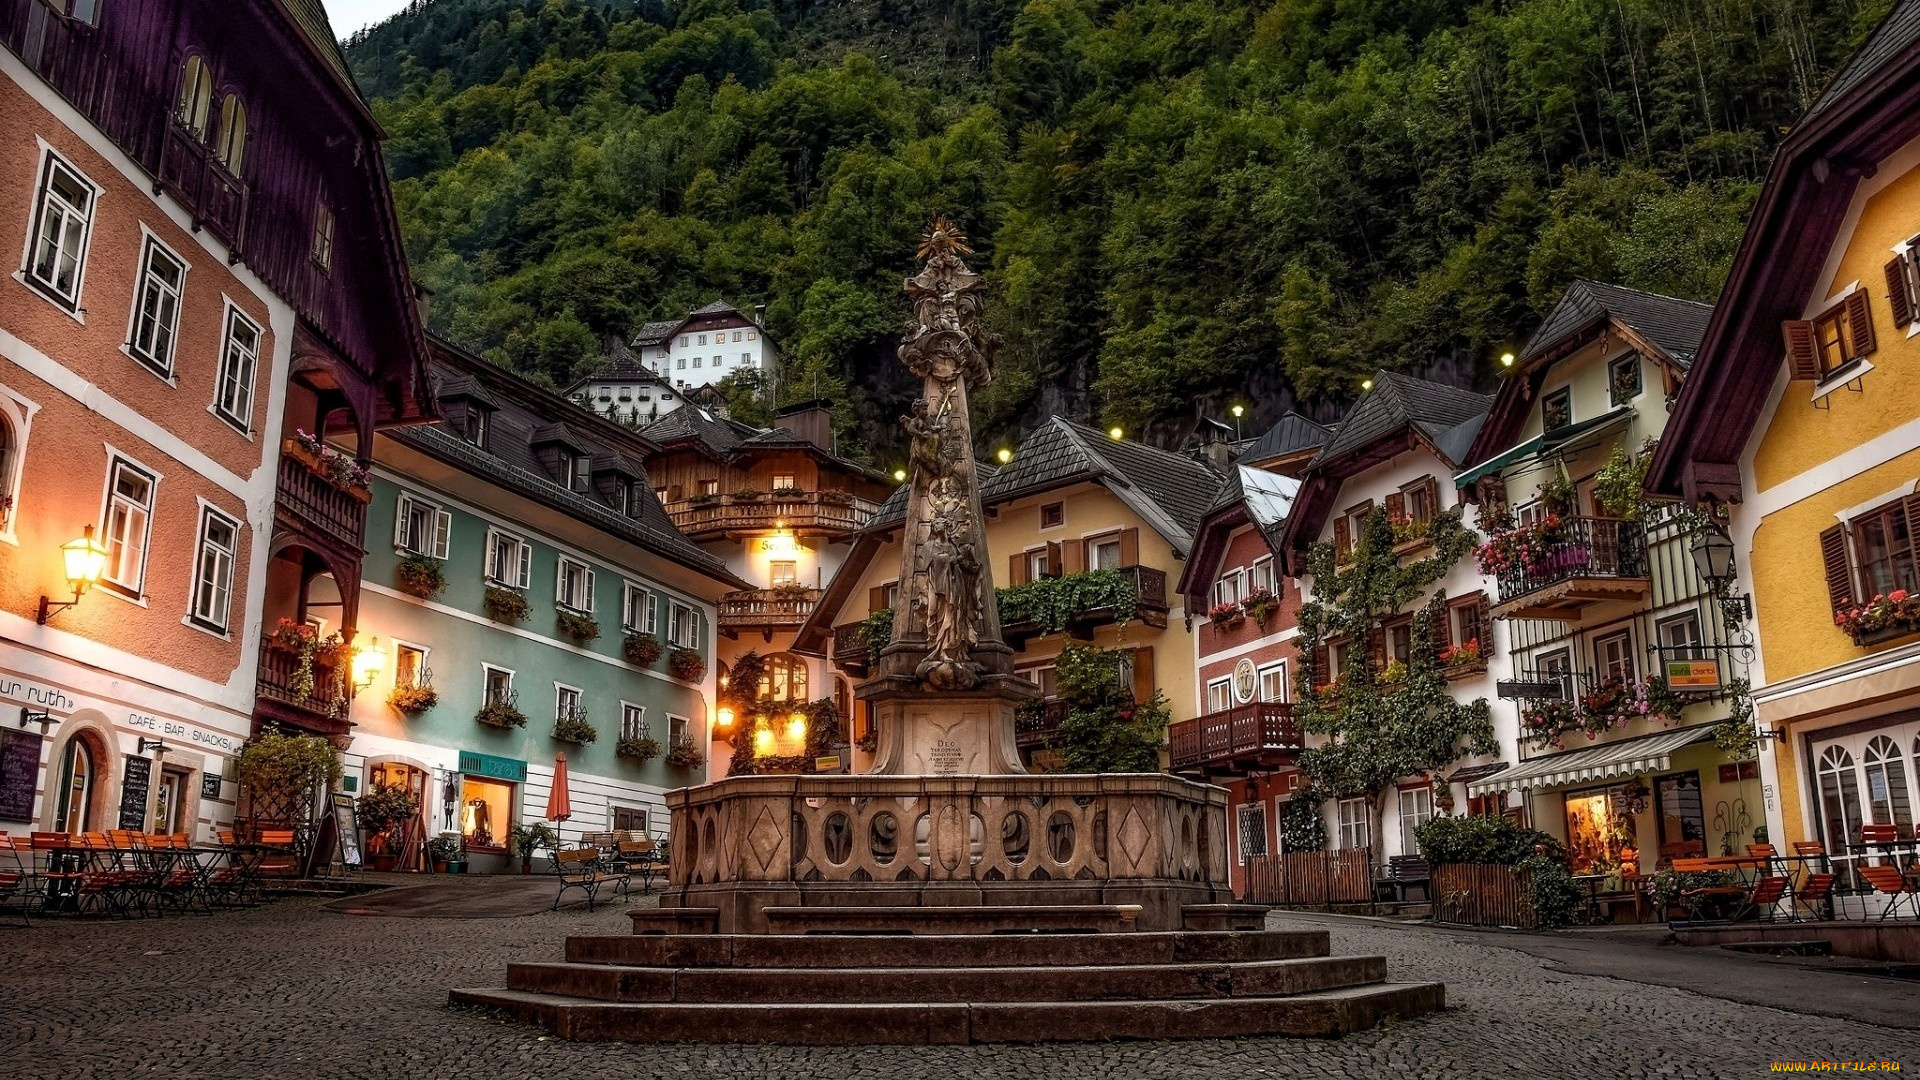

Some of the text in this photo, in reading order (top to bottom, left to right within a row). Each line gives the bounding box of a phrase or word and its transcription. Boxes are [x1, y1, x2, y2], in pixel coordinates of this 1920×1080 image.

[128, 713, 229, 749] CAFÉ BAR SNACKS
